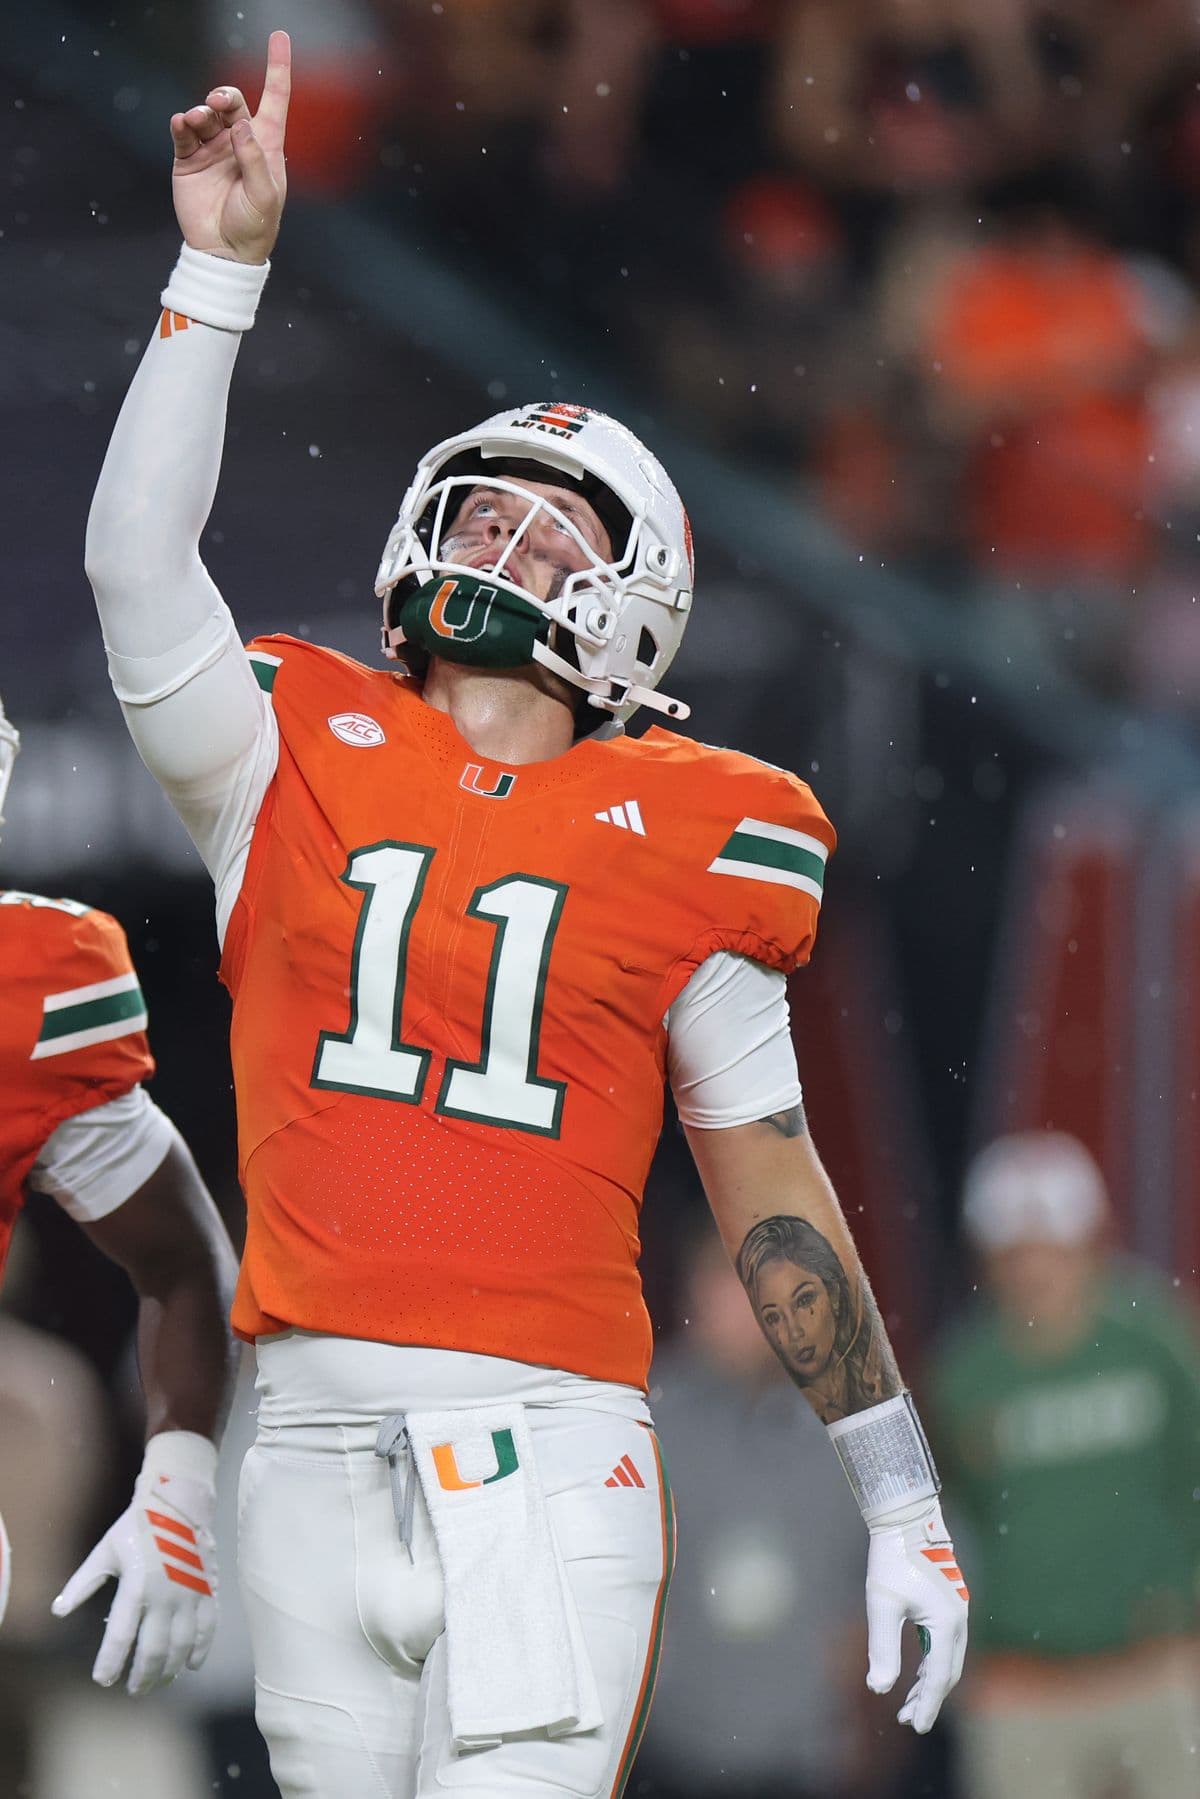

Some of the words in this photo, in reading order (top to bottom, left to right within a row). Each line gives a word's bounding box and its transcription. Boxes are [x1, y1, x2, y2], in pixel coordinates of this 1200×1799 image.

[510, 420, 573, 440] MIAMI
[429, 580, 498, 642] U
[332, 721, 380, 741] ACC
[460, 763, 517, 799] U
[310, 839, 569, 1140] 11
[431, 1428, 520, 1491] U
